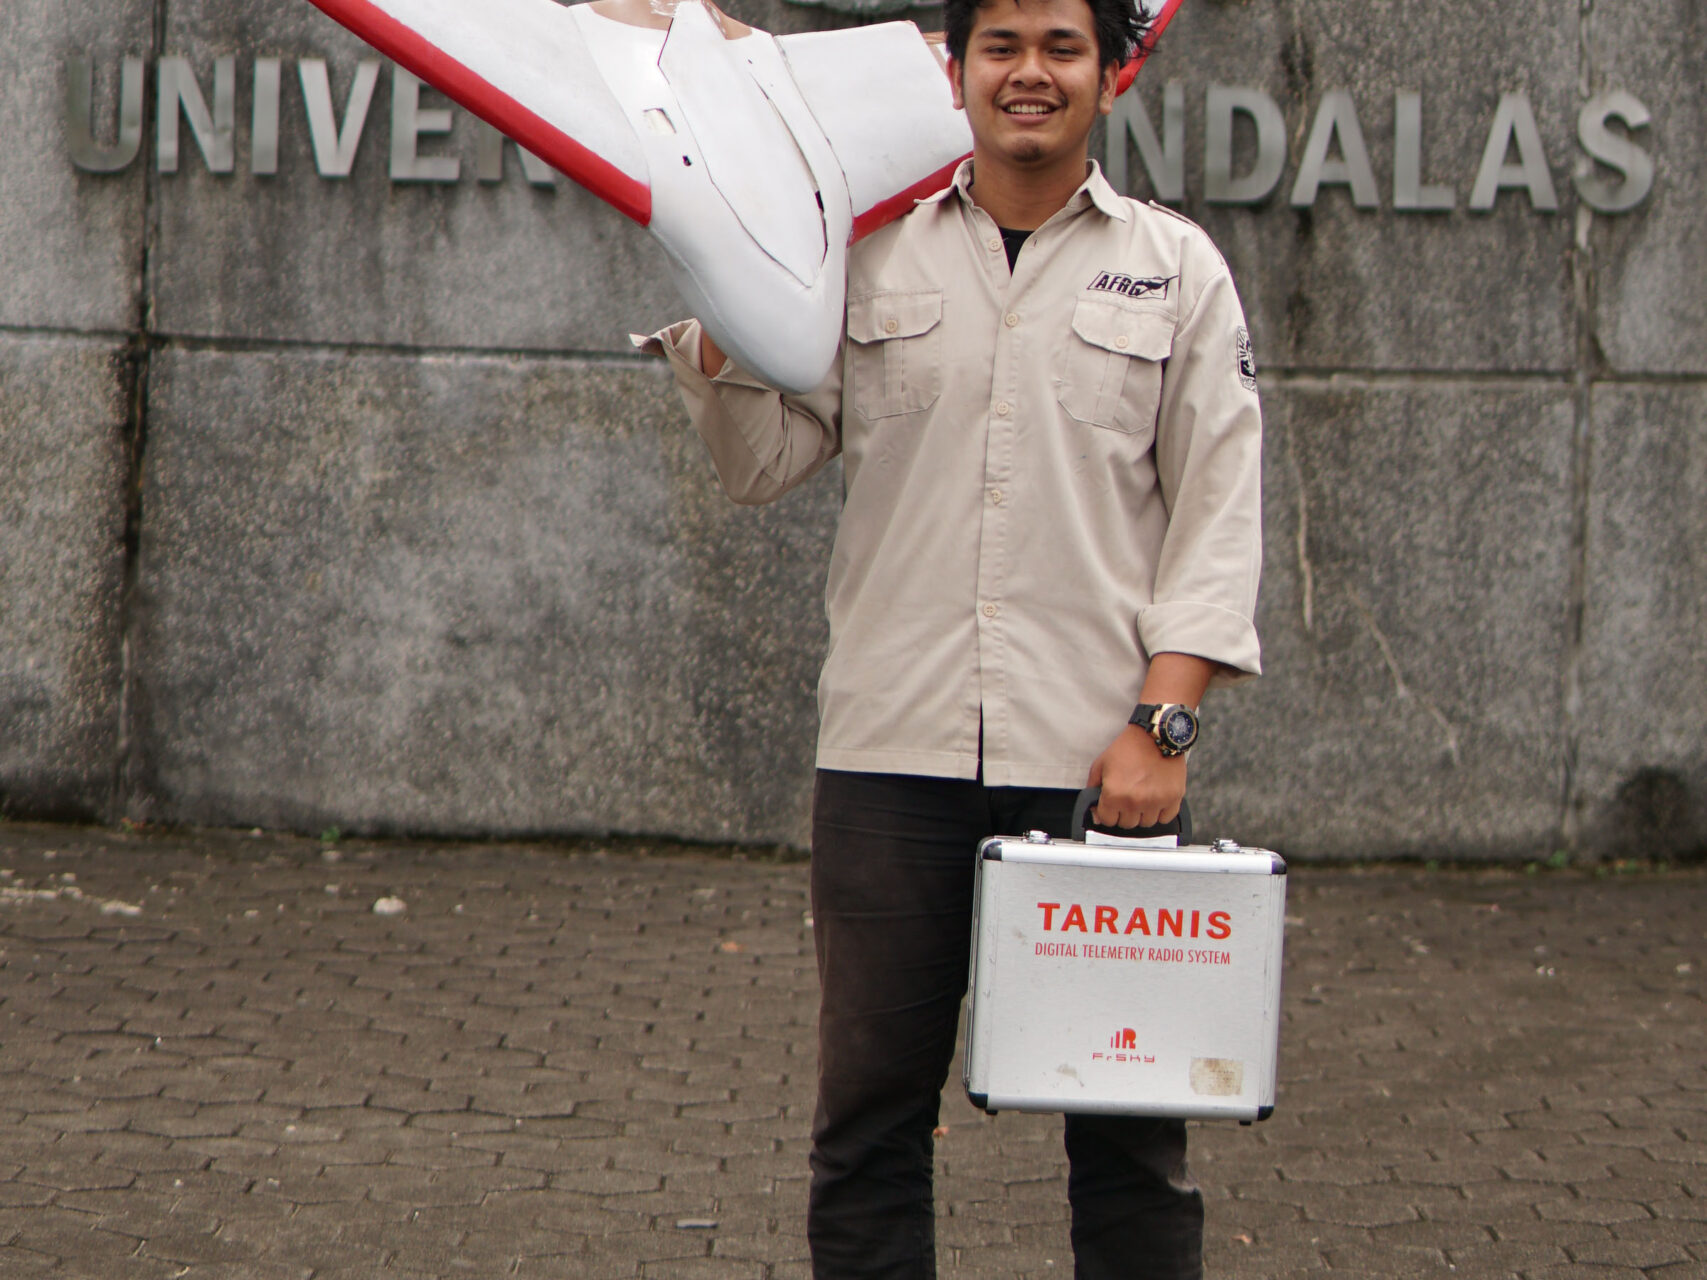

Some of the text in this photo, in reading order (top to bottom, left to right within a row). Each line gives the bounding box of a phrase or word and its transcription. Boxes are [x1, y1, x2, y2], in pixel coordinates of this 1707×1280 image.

[1106, 80, 1654, 212] NDALAS
[1037, 902, 1232, 940] TARANIS
[1035, 942, 1231, 965] DIGITAL TELEMETRY RADIO SYSTEM
